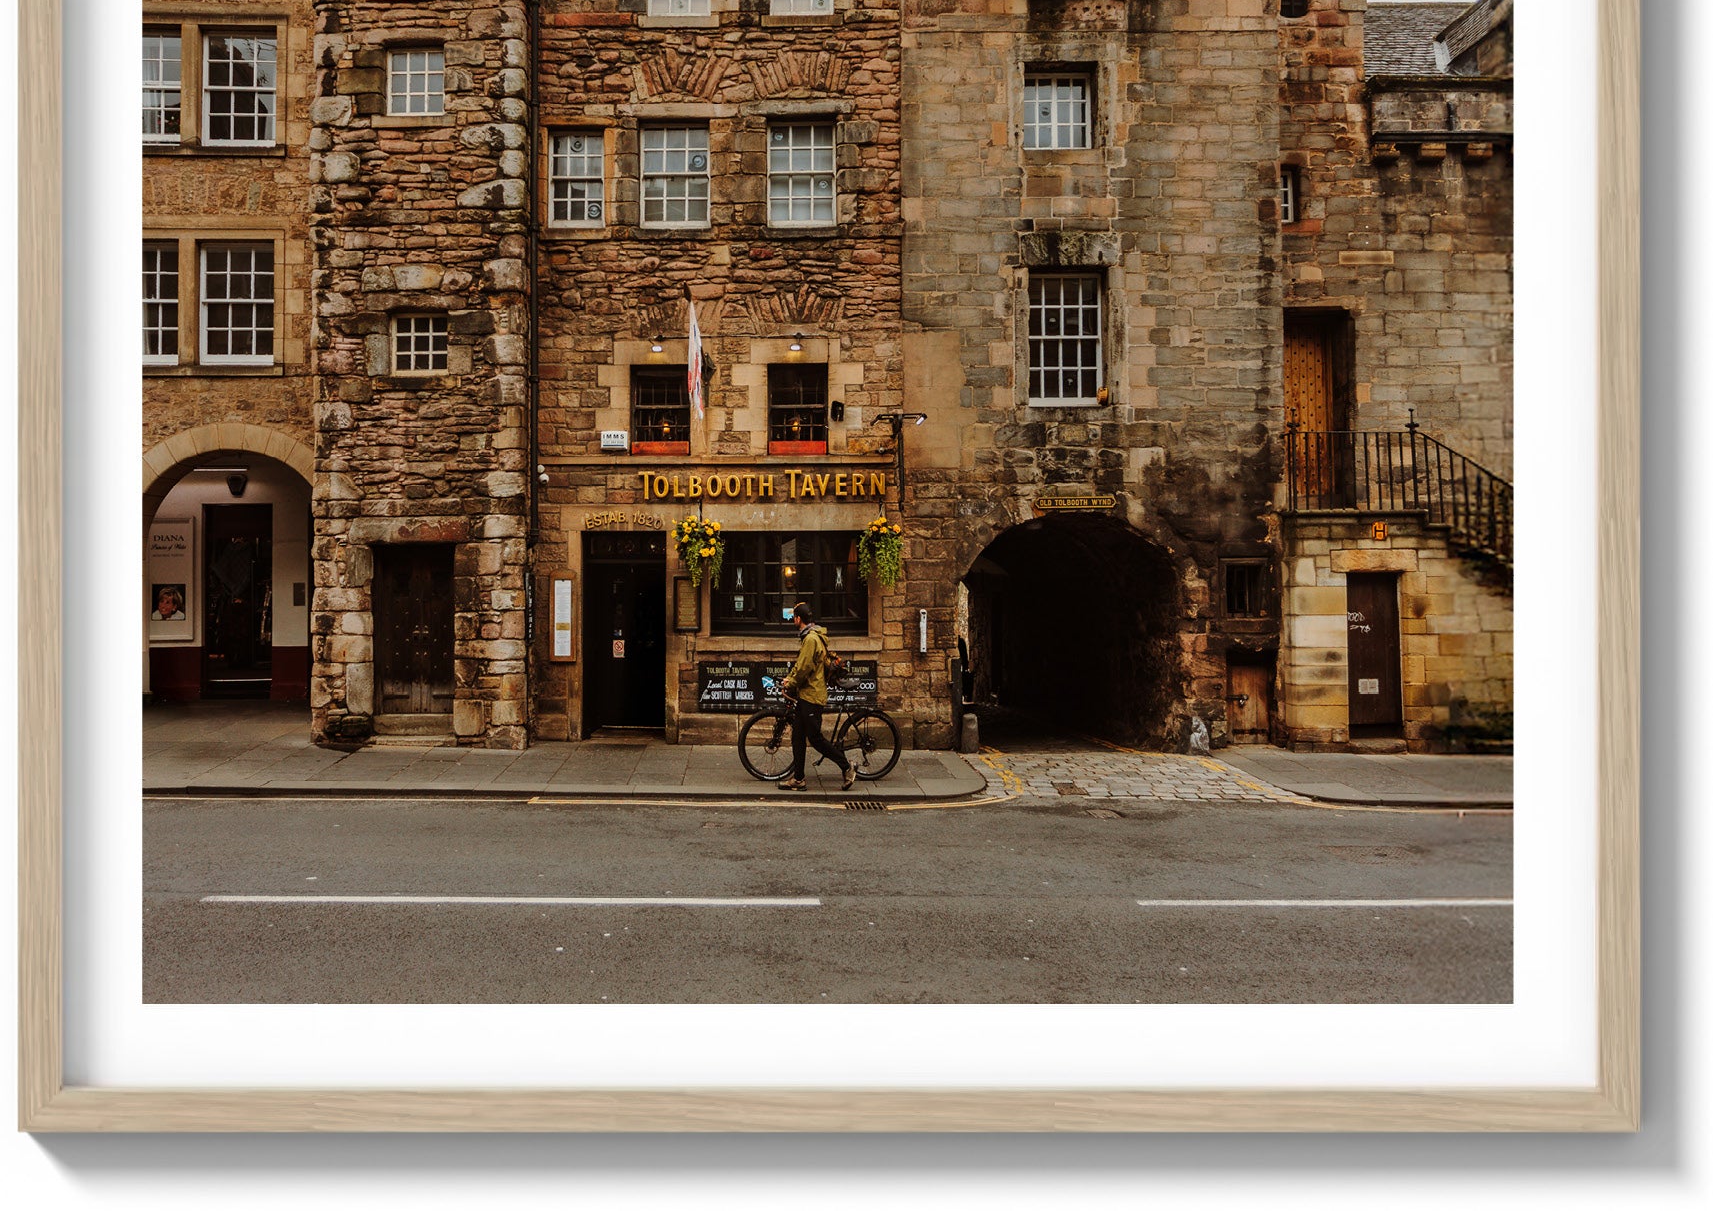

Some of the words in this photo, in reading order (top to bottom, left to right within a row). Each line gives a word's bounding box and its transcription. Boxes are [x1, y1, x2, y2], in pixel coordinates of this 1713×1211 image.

[638, 471, 774, 500] TOLBOOTH
[785, 469, 886, 499] TAVERN
[1039, 499, 1052, 507] OLD
[1054, 498, 1088, 507] TOLBOOTH
[1091, 498, 1112, 506] WYND
[585, 511, 629, 529] ESTAB.
[632, 512, 663, 529] 1820
[153, 534, 185, 542] DIANA
[736, 679, 748, 689] ALES
